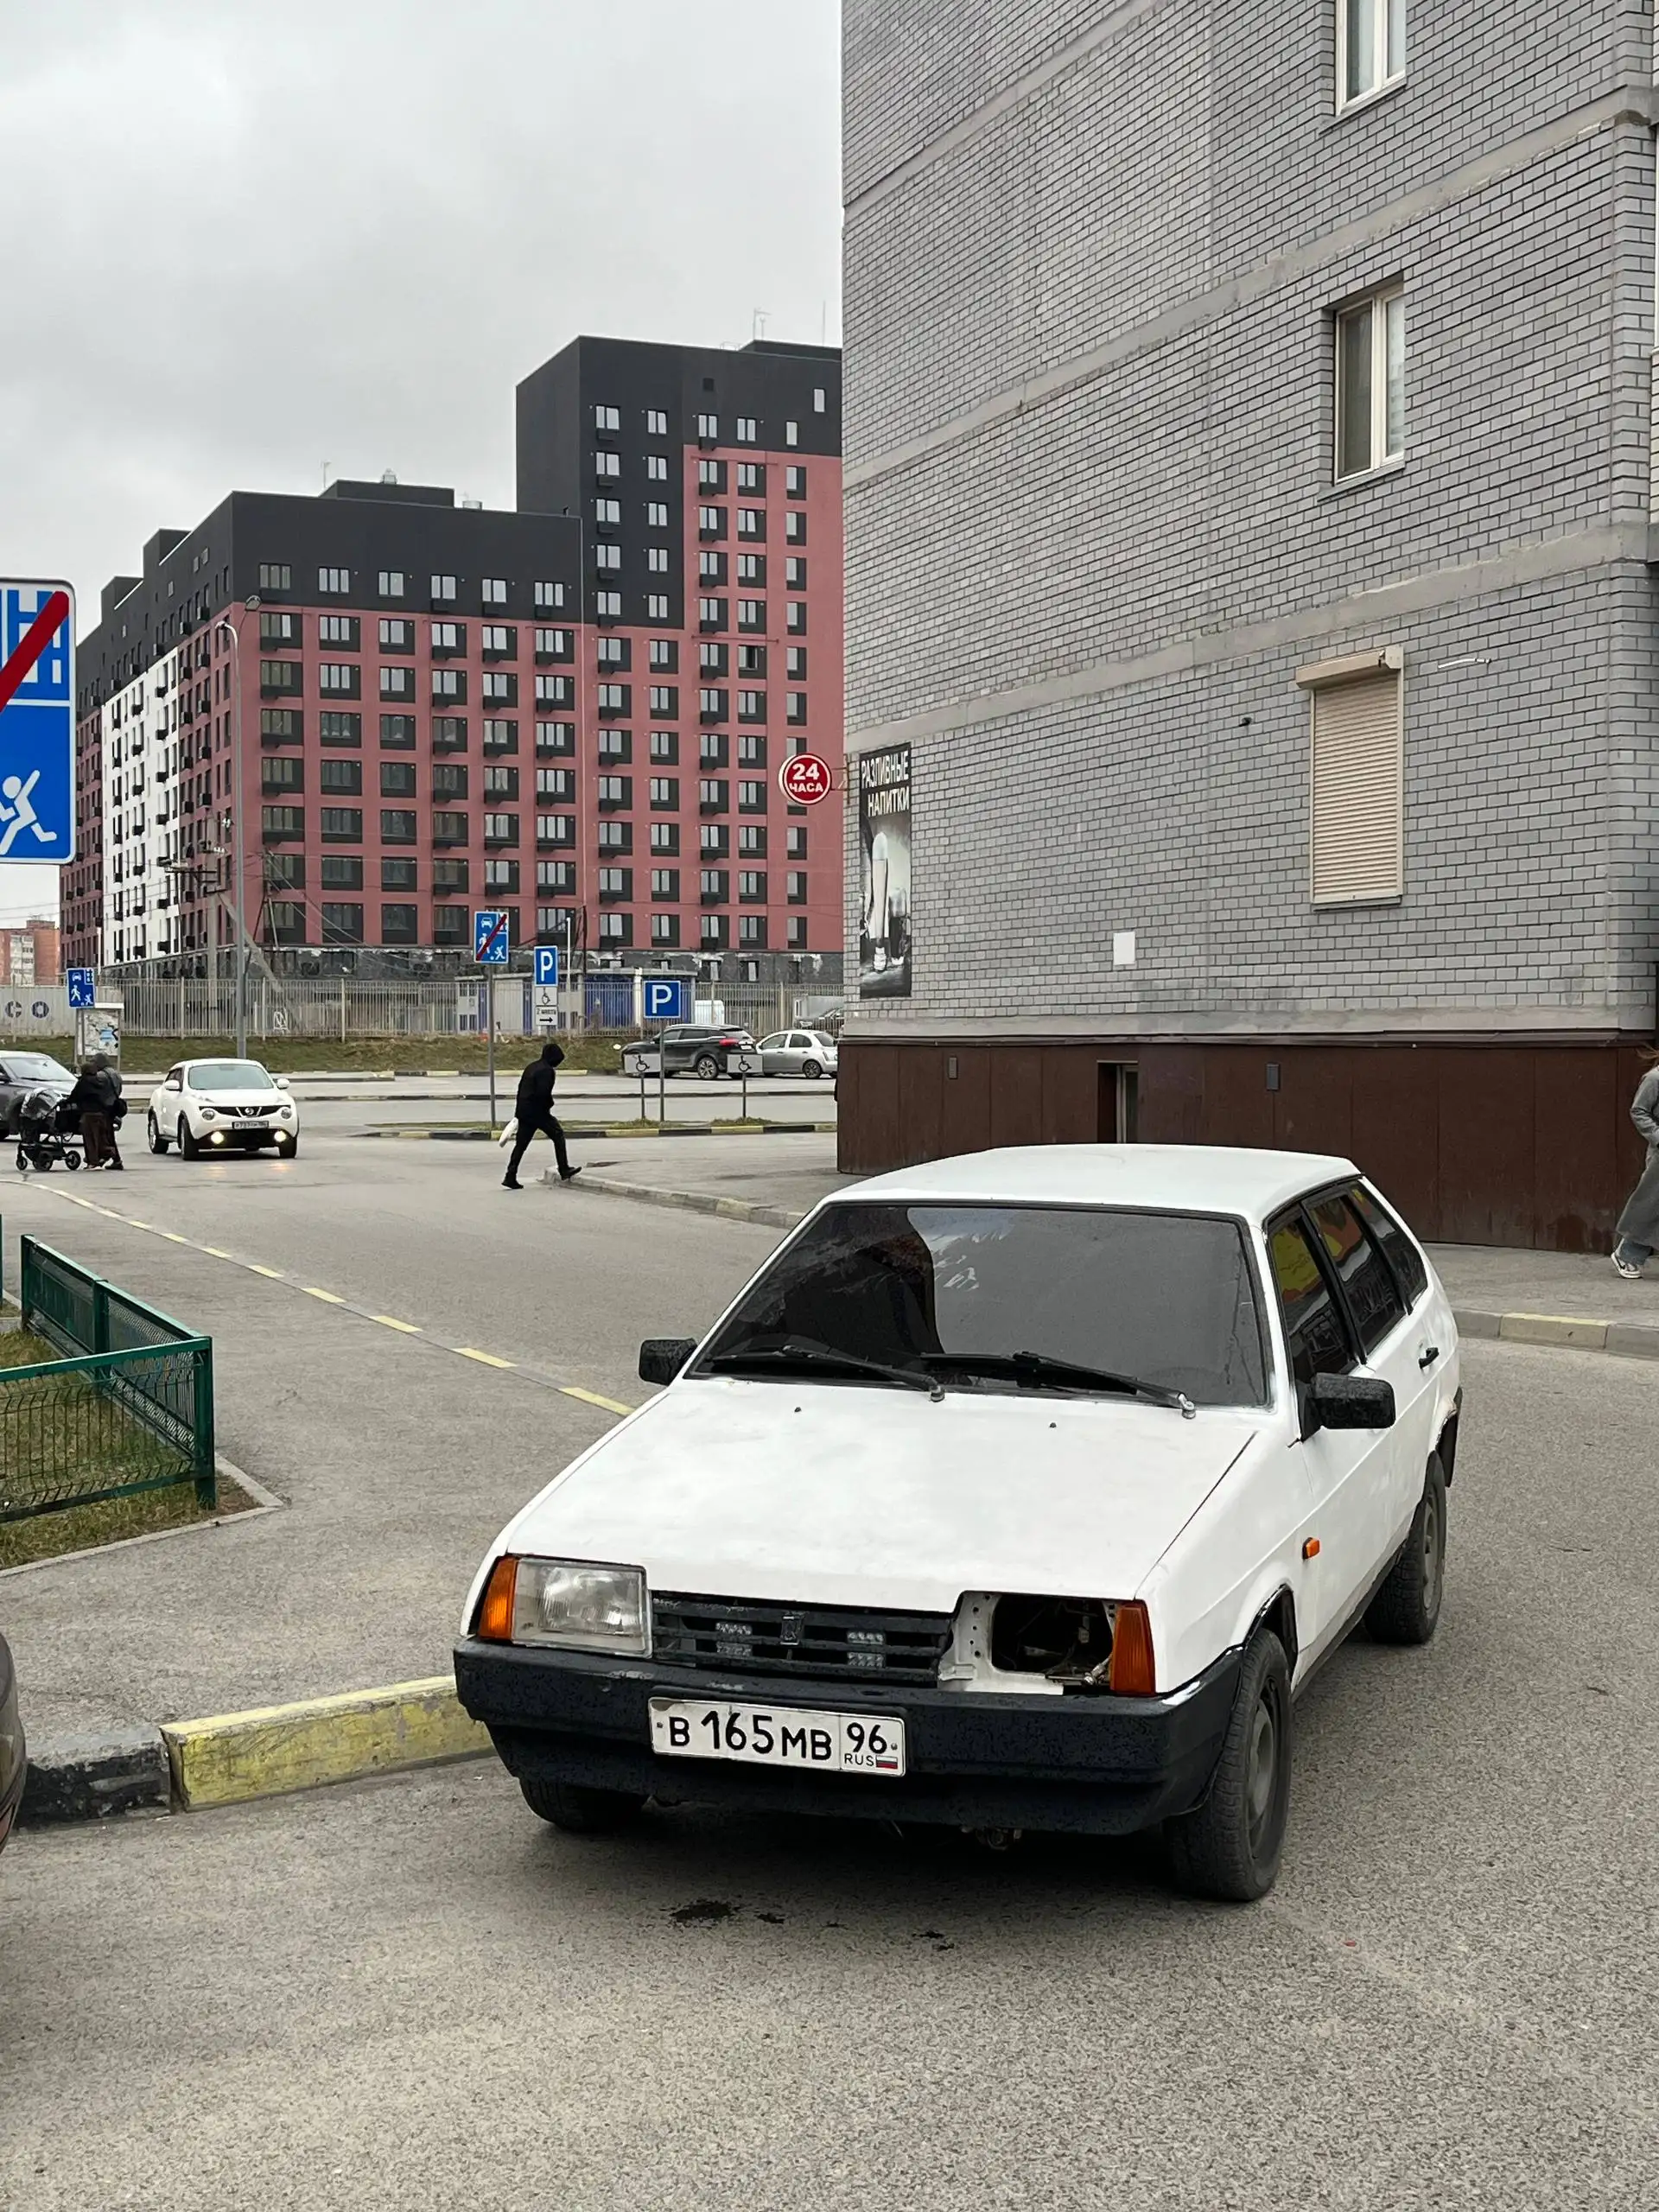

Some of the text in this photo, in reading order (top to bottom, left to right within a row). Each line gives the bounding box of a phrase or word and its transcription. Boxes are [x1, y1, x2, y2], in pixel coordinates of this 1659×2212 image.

[792, 763, 820, 780] 24
[861, 750, 909, 789] РАЗЛИВНЫЕ
[788, 782, 824, 792] ЧАСА
[868, 785, 910, 817] НАПИТКИ
[540, 950, 554, 982] P
[652, 984, 672, 1014] P
[846, 1721, 888, 1754] 96
[843, 1752, 874, 1767] RUS
